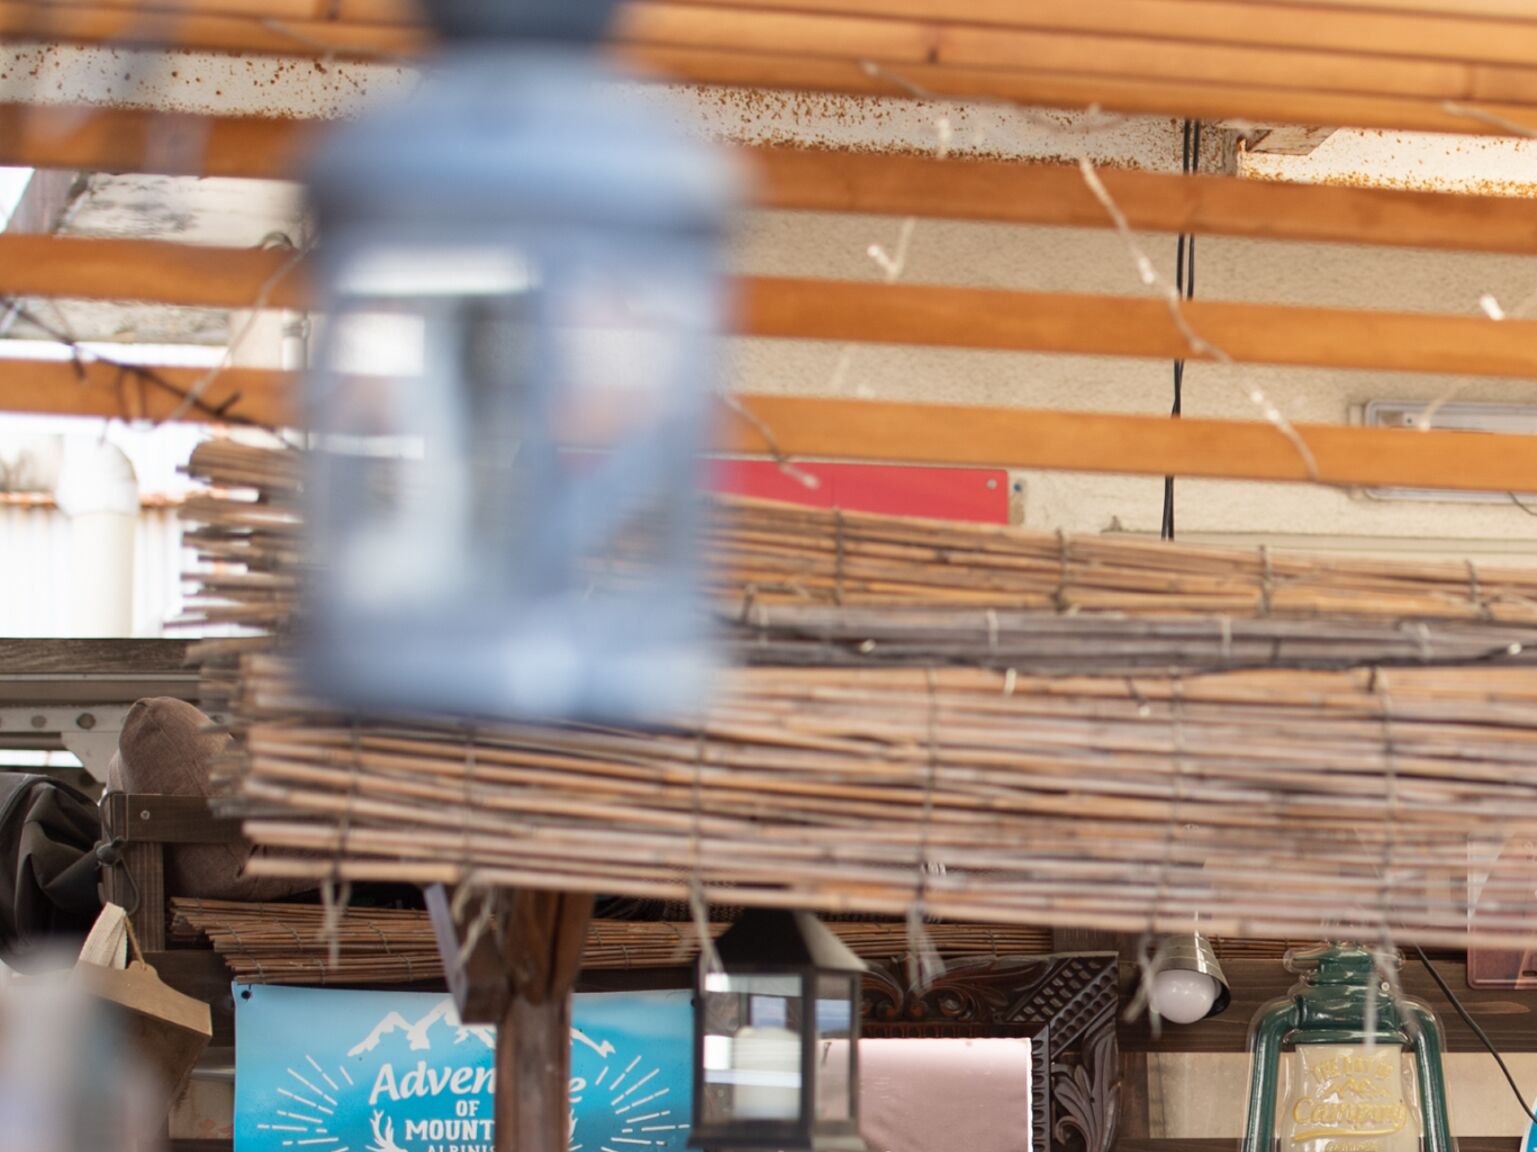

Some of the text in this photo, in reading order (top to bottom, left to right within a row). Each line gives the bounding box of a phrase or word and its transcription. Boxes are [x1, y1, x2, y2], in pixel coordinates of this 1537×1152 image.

[455, 1100, 480, 1117] OF
[1293, 1097, 1407, 1131] Camping
[405, 1120, 495, 1141] MOUNT
